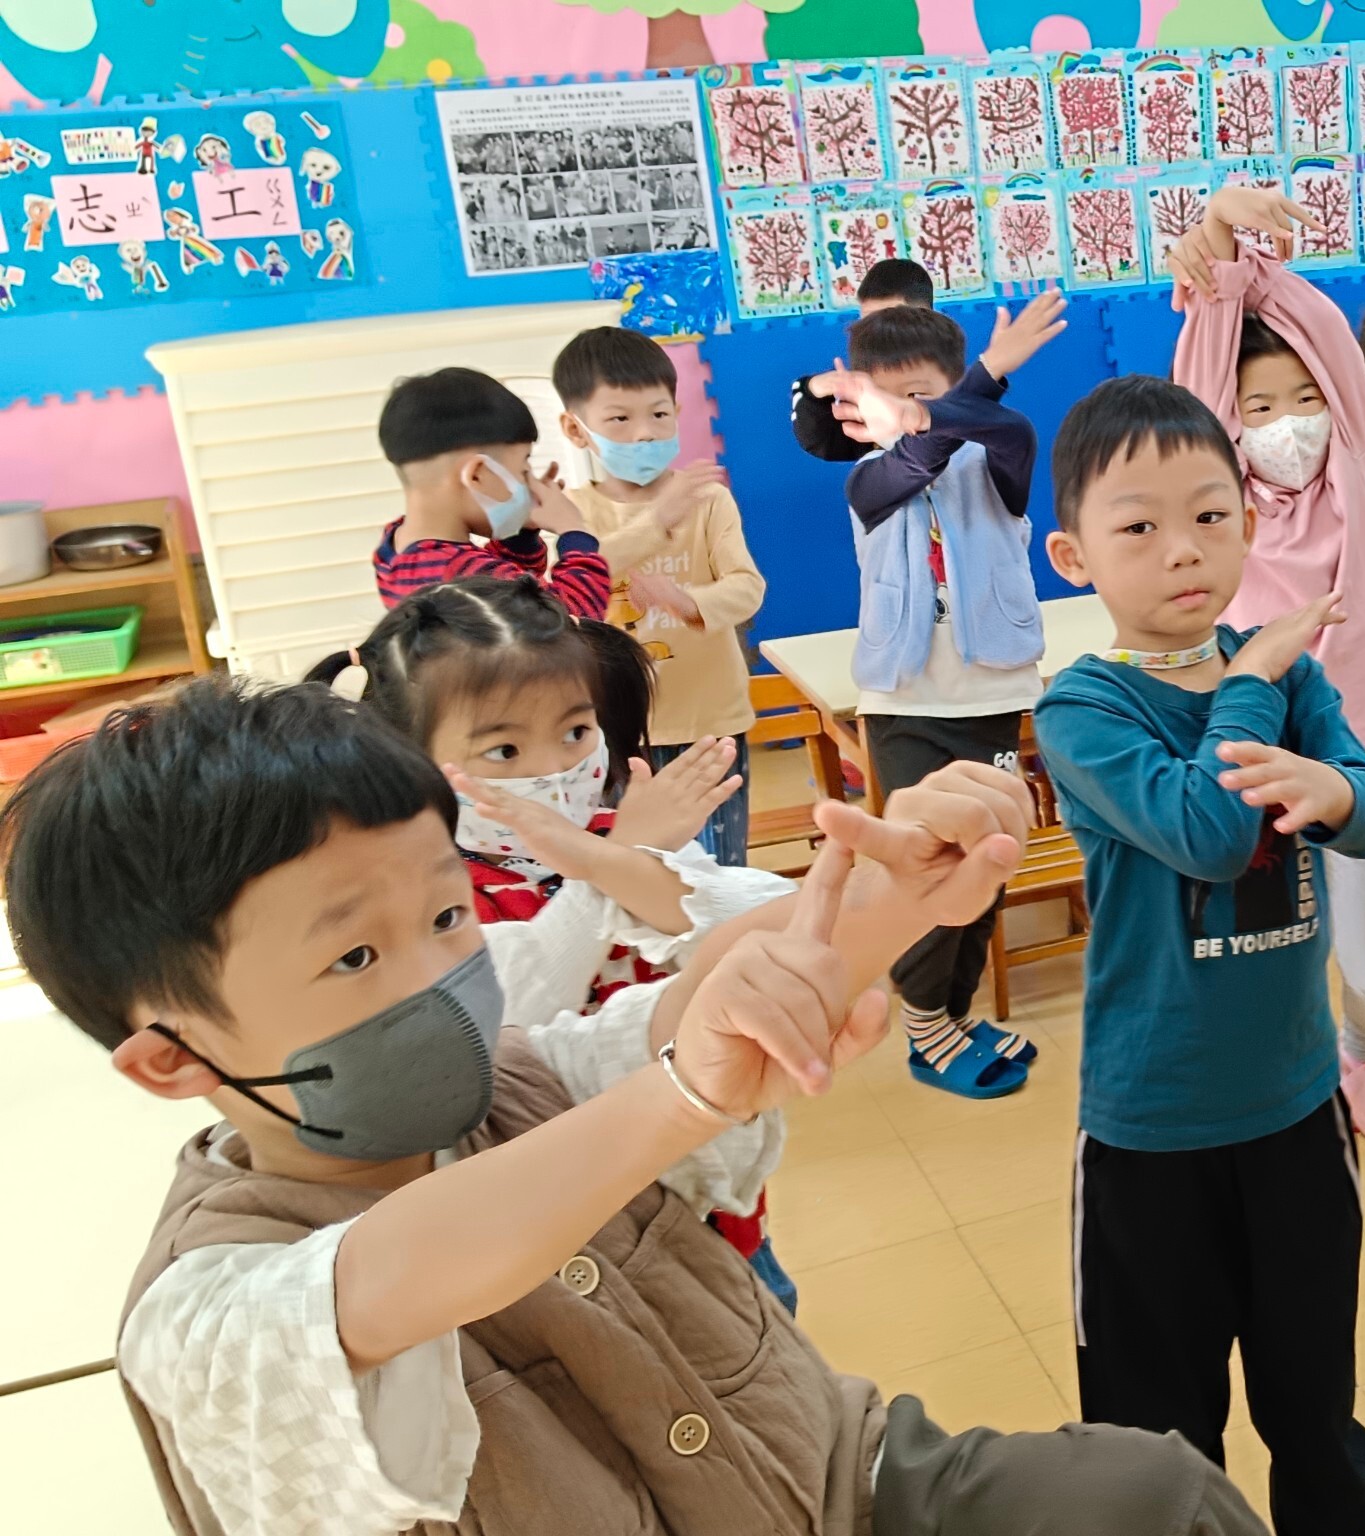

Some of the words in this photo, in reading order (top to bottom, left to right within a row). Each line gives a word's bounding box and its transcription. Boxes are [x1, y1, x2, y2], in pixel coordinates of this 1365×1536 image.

[68, 183, 118, 234] 志
[211, 186, 262, 222] 工
[1193, 938, 1224, 959] BE
[1228, 916, 1320, 955] YOURSELF
